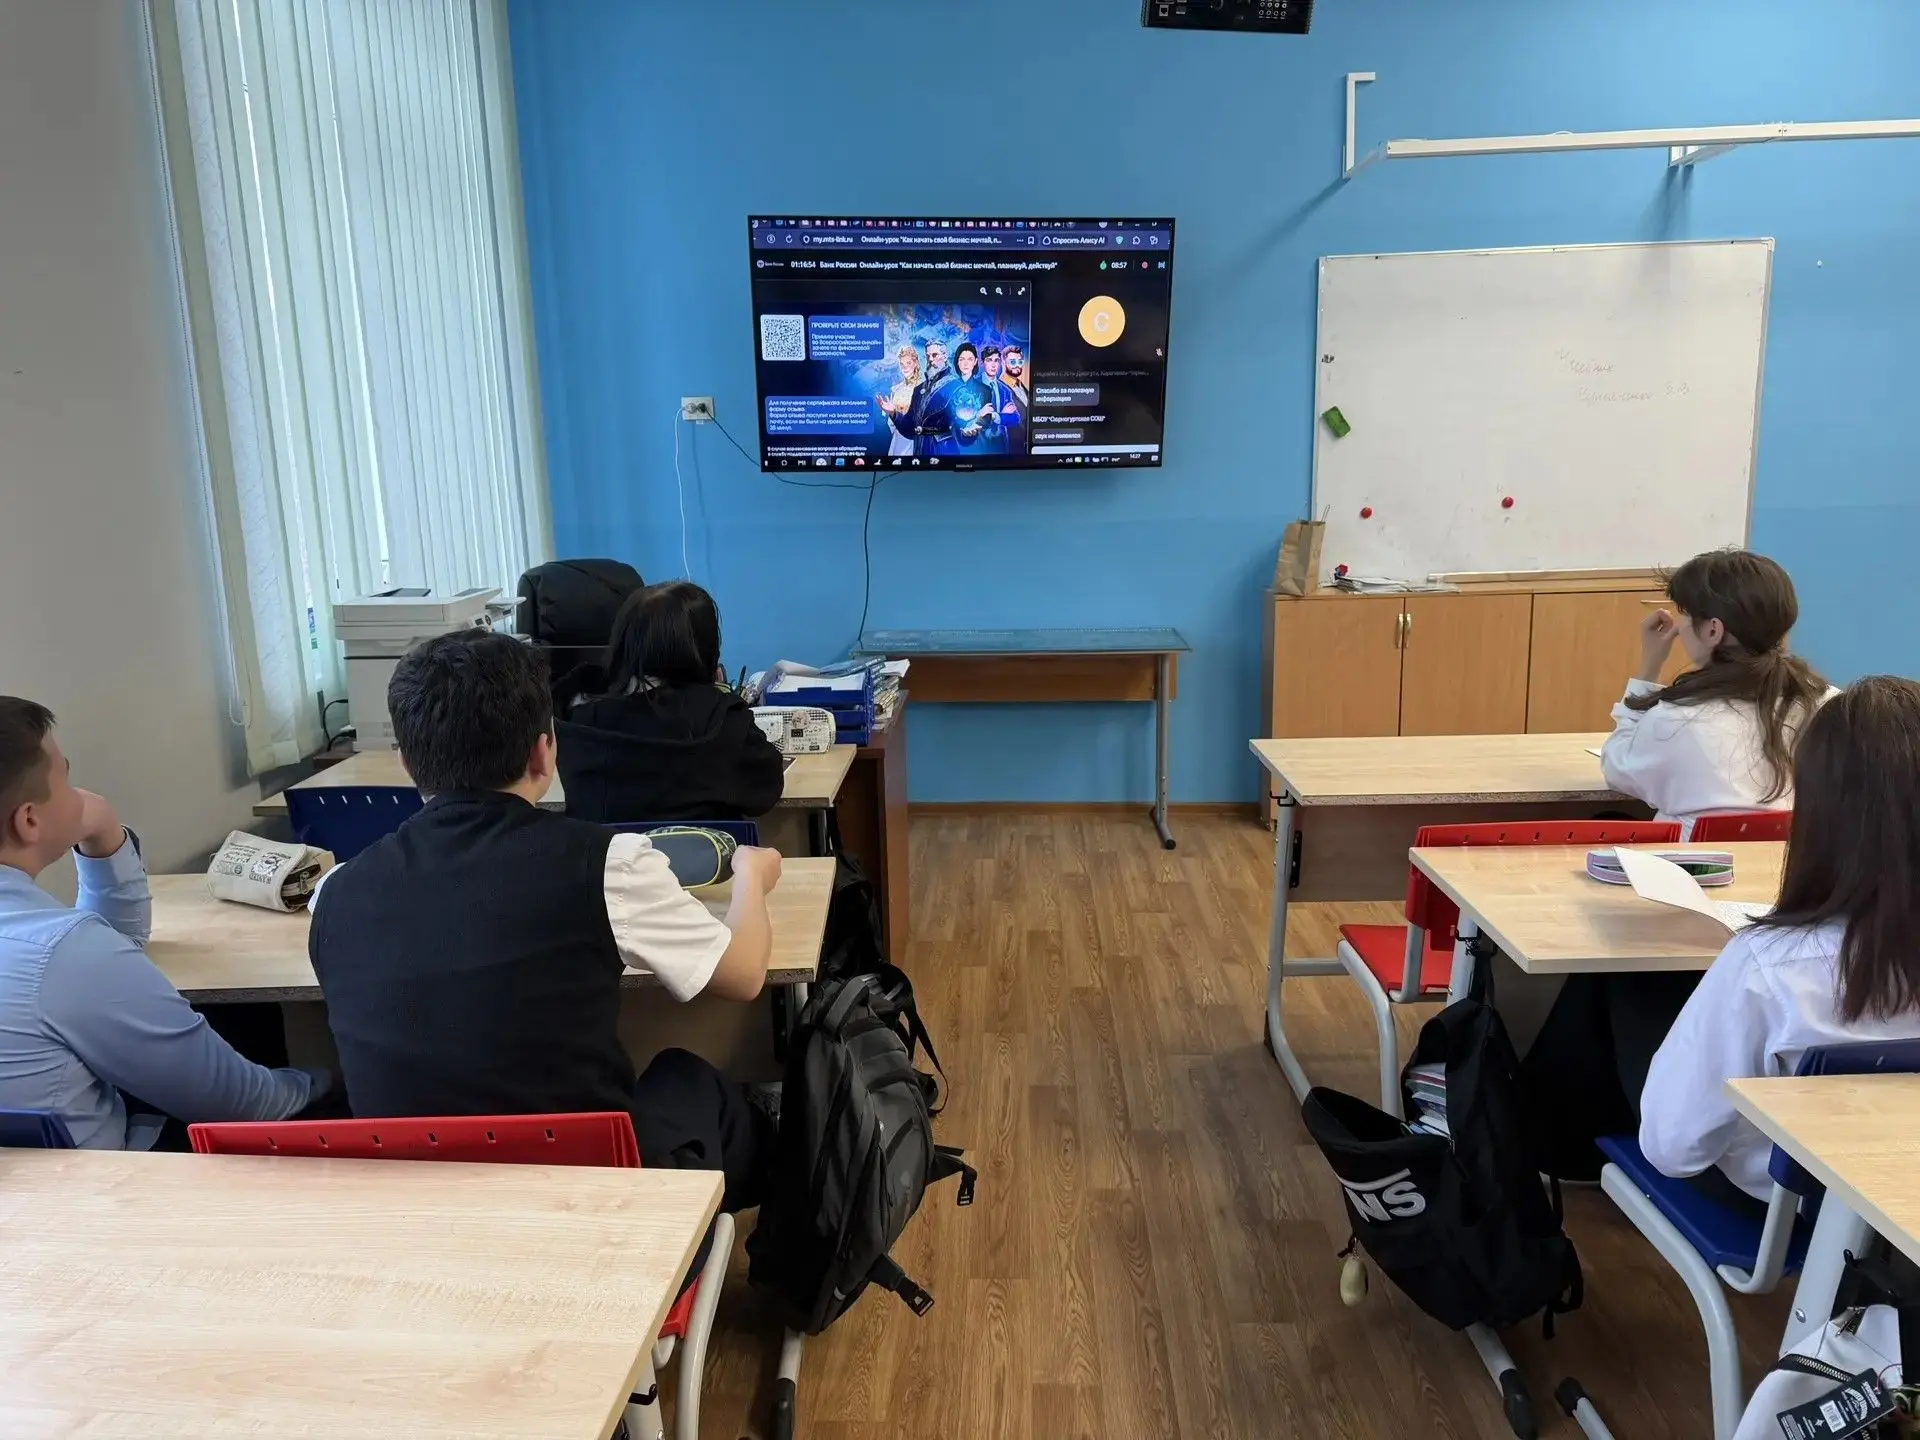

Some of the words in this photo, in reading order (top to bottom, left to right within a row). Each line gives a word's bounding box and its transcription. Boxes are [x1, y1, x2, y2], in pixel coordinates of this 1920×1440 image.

[812, 235, 853, 244] my.mts-link.ru
[1053, 236, 1080, 245] Спросить
[1080, 236, 1098, 245] Алису
[859, 261, 899, 270] Онлайн-урок
